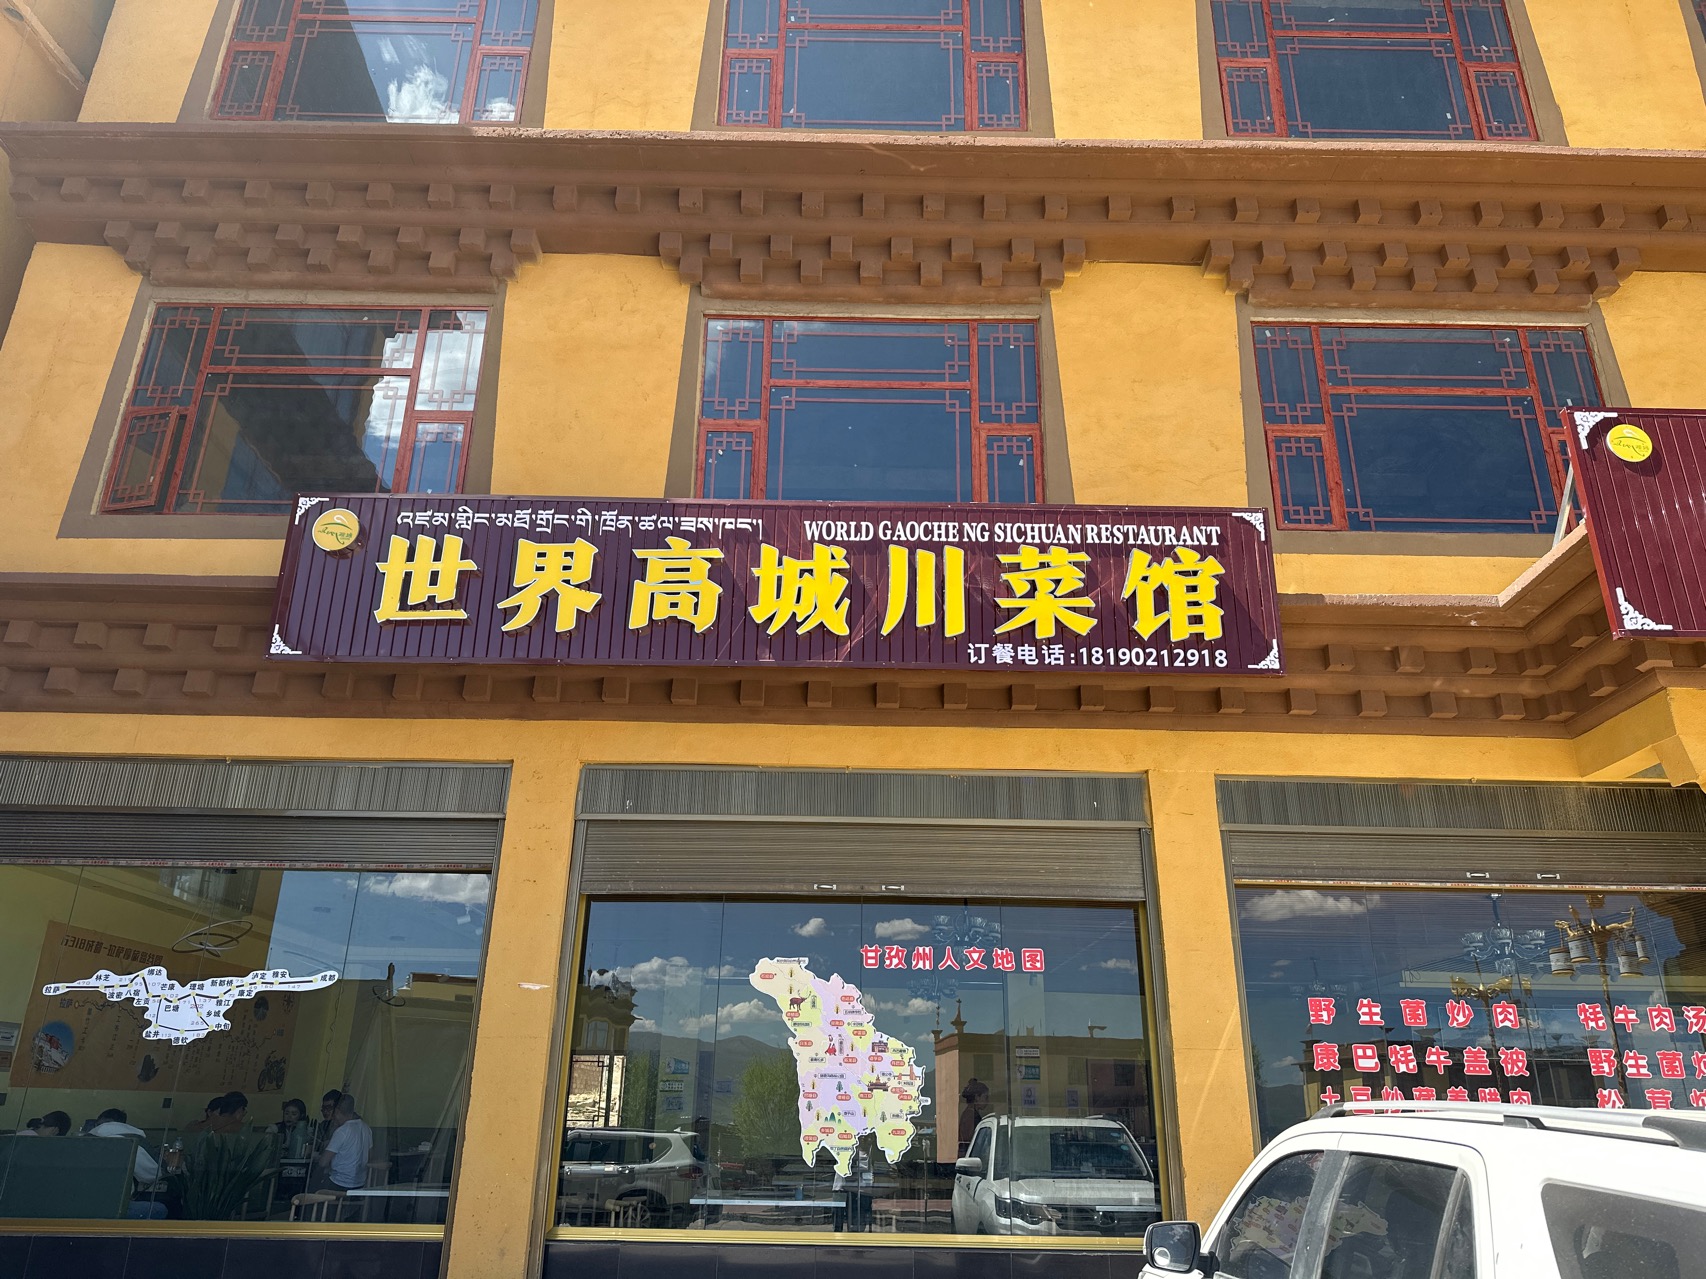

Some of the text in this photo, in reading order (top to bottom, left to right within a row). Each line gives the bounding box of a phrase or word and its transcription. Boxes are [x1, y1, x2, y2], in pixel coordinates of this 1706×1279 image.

[804, 520, 874, 541] WORLD
[994, 522, 1081, 545] SICHUAN
[1085, 524, 1221, 546] RESTAURANT
[373, 534, 1226, 642] 世界高城川菜馆
[860, 944, 1045, 972] 甘孜州人文地图
[44, 985, 60, 994] 拉萨
[94, 973, 111, 982] 林芝
[319, 973, 336, 982] 成都
[164, 1004, 180, 1013] 巴塘
[205, 1009, 222, 1018] 乡城
[1307, 997, 1520, 1030] 野生菌炒肉
[1576, 1002, 1706, 1034] 牦牛肉汤
[1312, 1041, 1530, 1077] 康巴牦牛盖被
